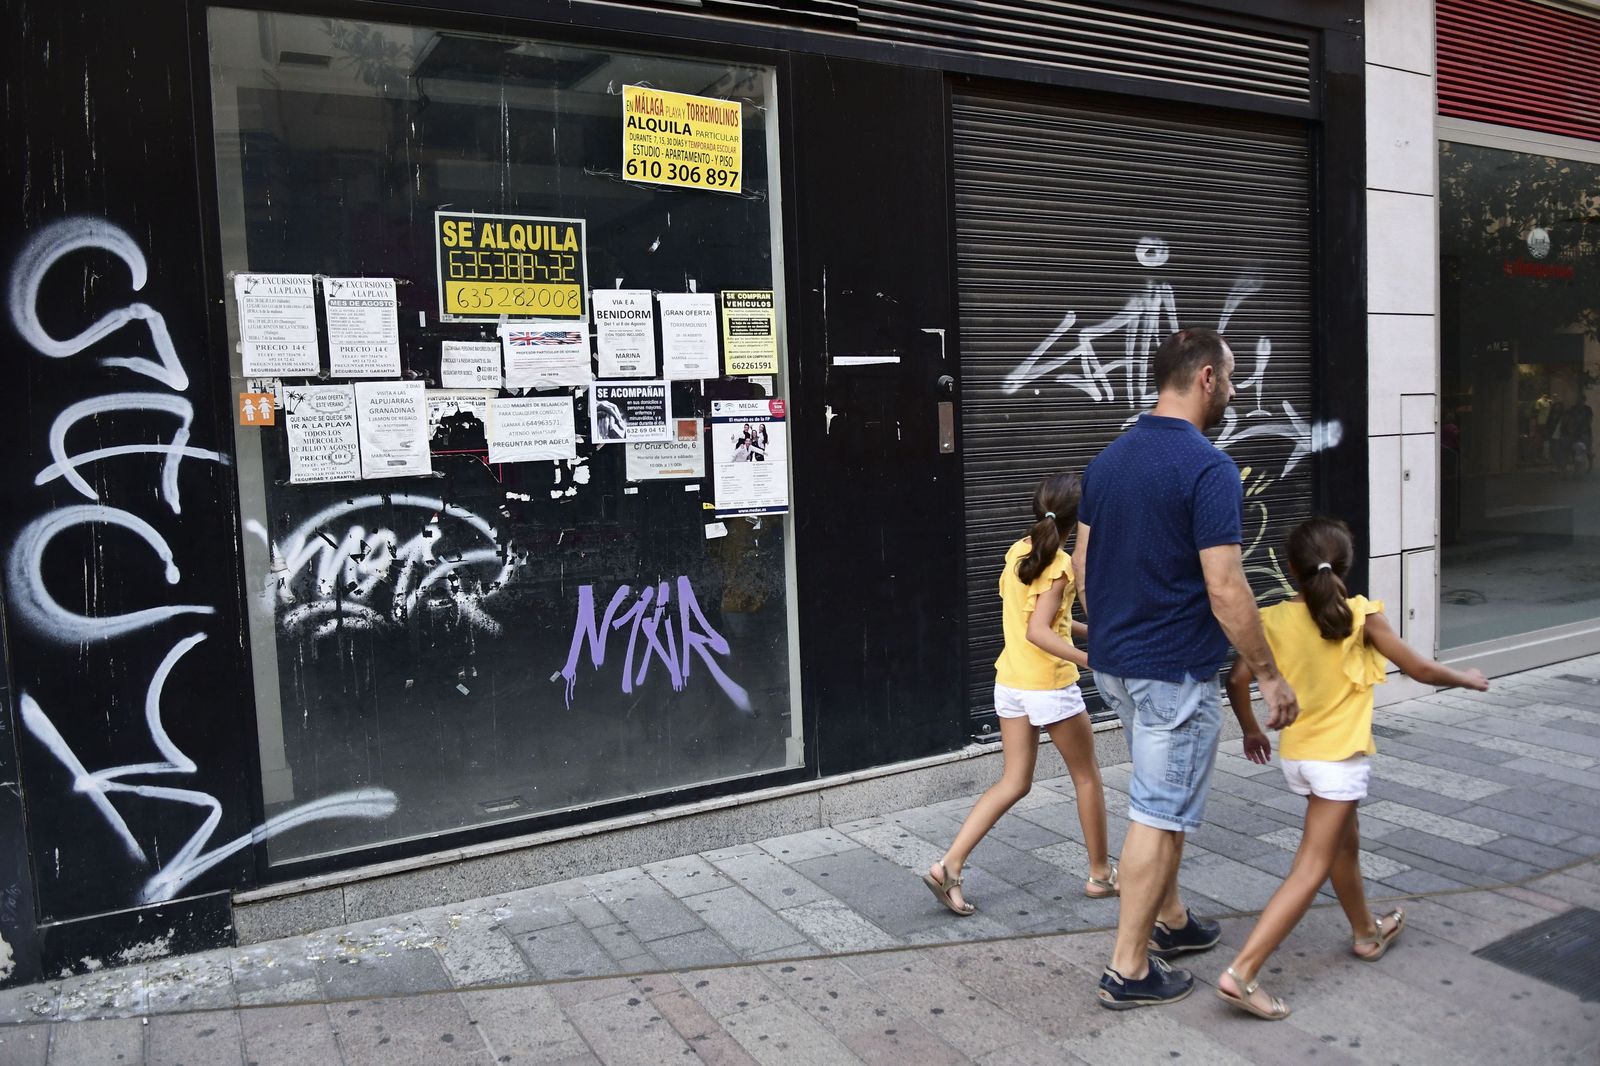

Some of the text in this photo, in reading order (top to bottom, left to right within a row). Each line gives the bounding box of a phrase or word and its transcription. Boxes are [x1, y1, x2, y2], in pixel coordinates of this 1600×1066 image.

[626, 93, 738, 127] EN MÁLAGA PLAYA Y TORREMOLINOS
[627, 116, 739, 142] ALQUILA PARTICULAR
[630, 133, 652, 143] DURANTE
[666, 137, 672, 146] 30
[673, 137, 684, 147] DÍAS
[688, 140, 716, 151] TEMPORADA
[717, 144, 736, 154] ESCOLAR
[633, 144, 733, 168] ESTUDIO APARTAMENTO Y PISO
[626, 158, 739, 187] 610 306 897
[442, 221, 578, 251] SE ALQUILA
[262, 277, 312, 285] EXCURSIONES
[457, 287, 579, 309] 635282008
[597, 310, 651, 319] BENIDORM
[597, 386, 664, 398] SE ACOMPAÑAN
